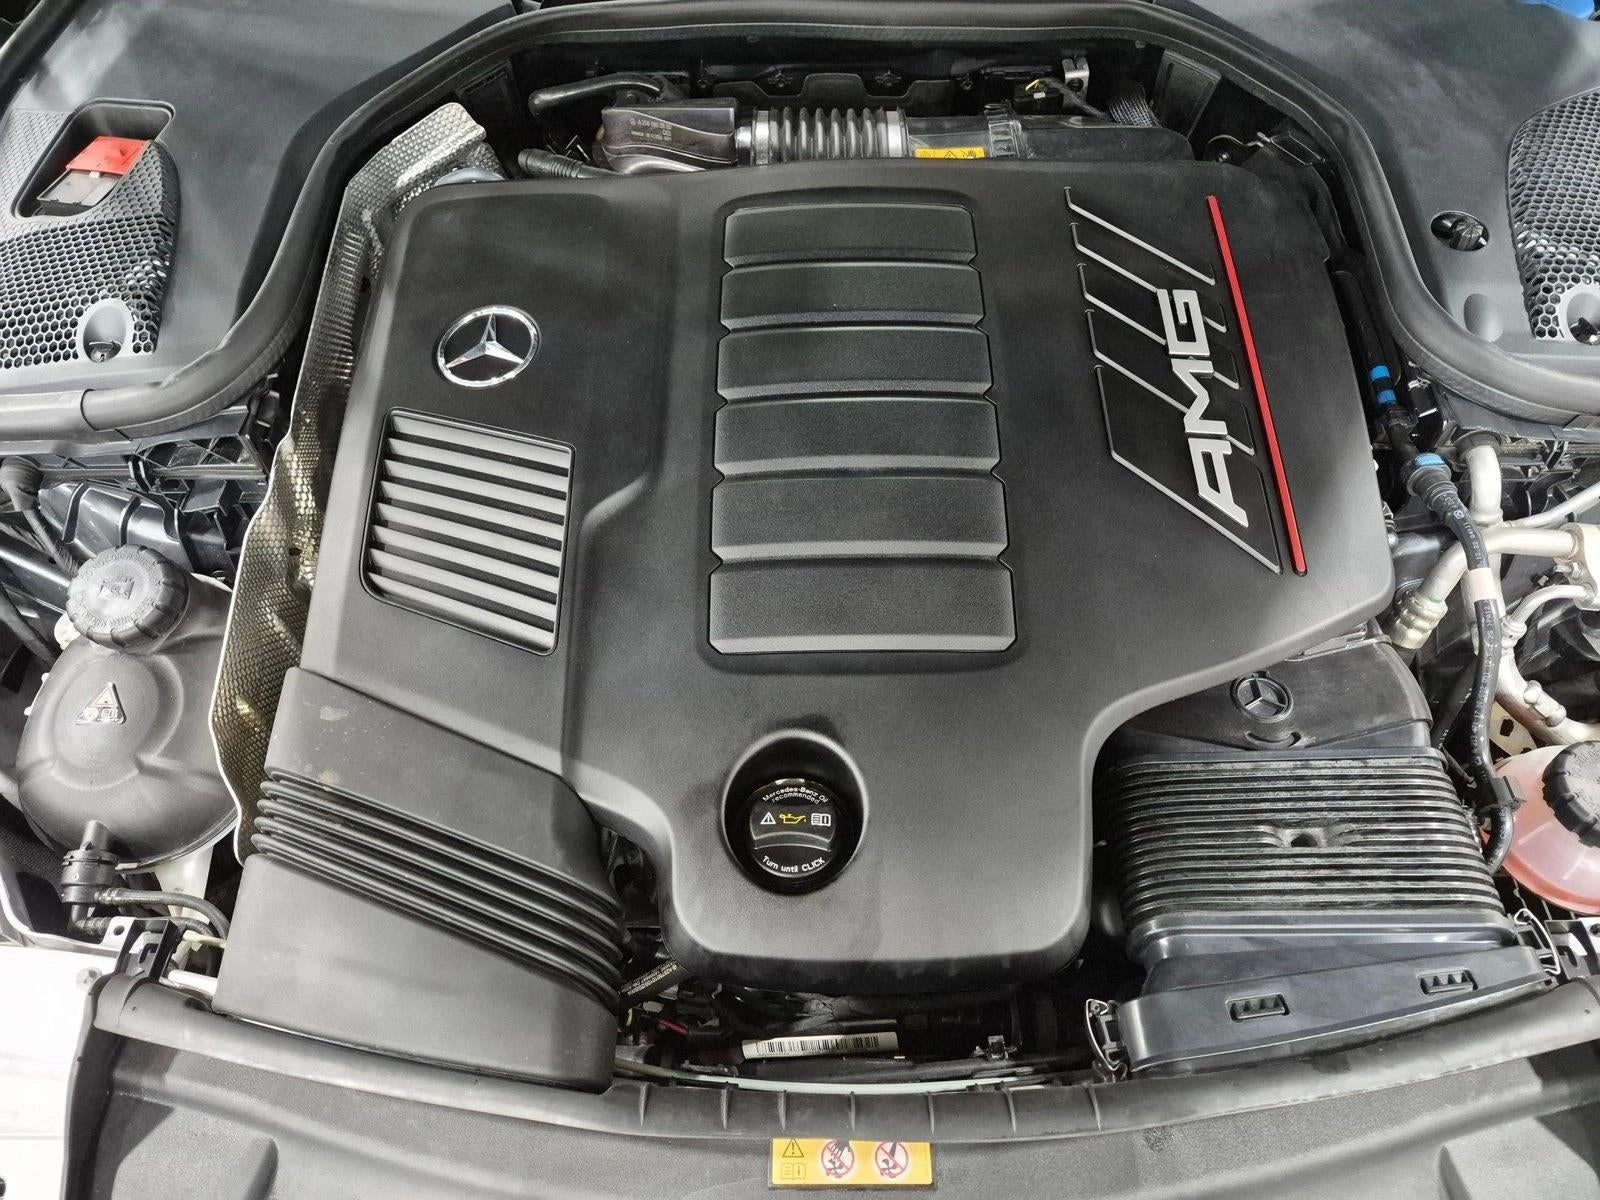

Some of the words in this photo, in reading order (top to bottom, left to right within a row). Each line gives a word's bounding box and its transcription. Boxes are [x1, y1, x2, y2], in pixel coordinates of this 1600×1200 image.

[1157, 289, 1249, 528] AMG
[762, 855, 779, 870] Turn
[780, 865, 799, 873] until
[801, 856, 826, 872] CLICK
